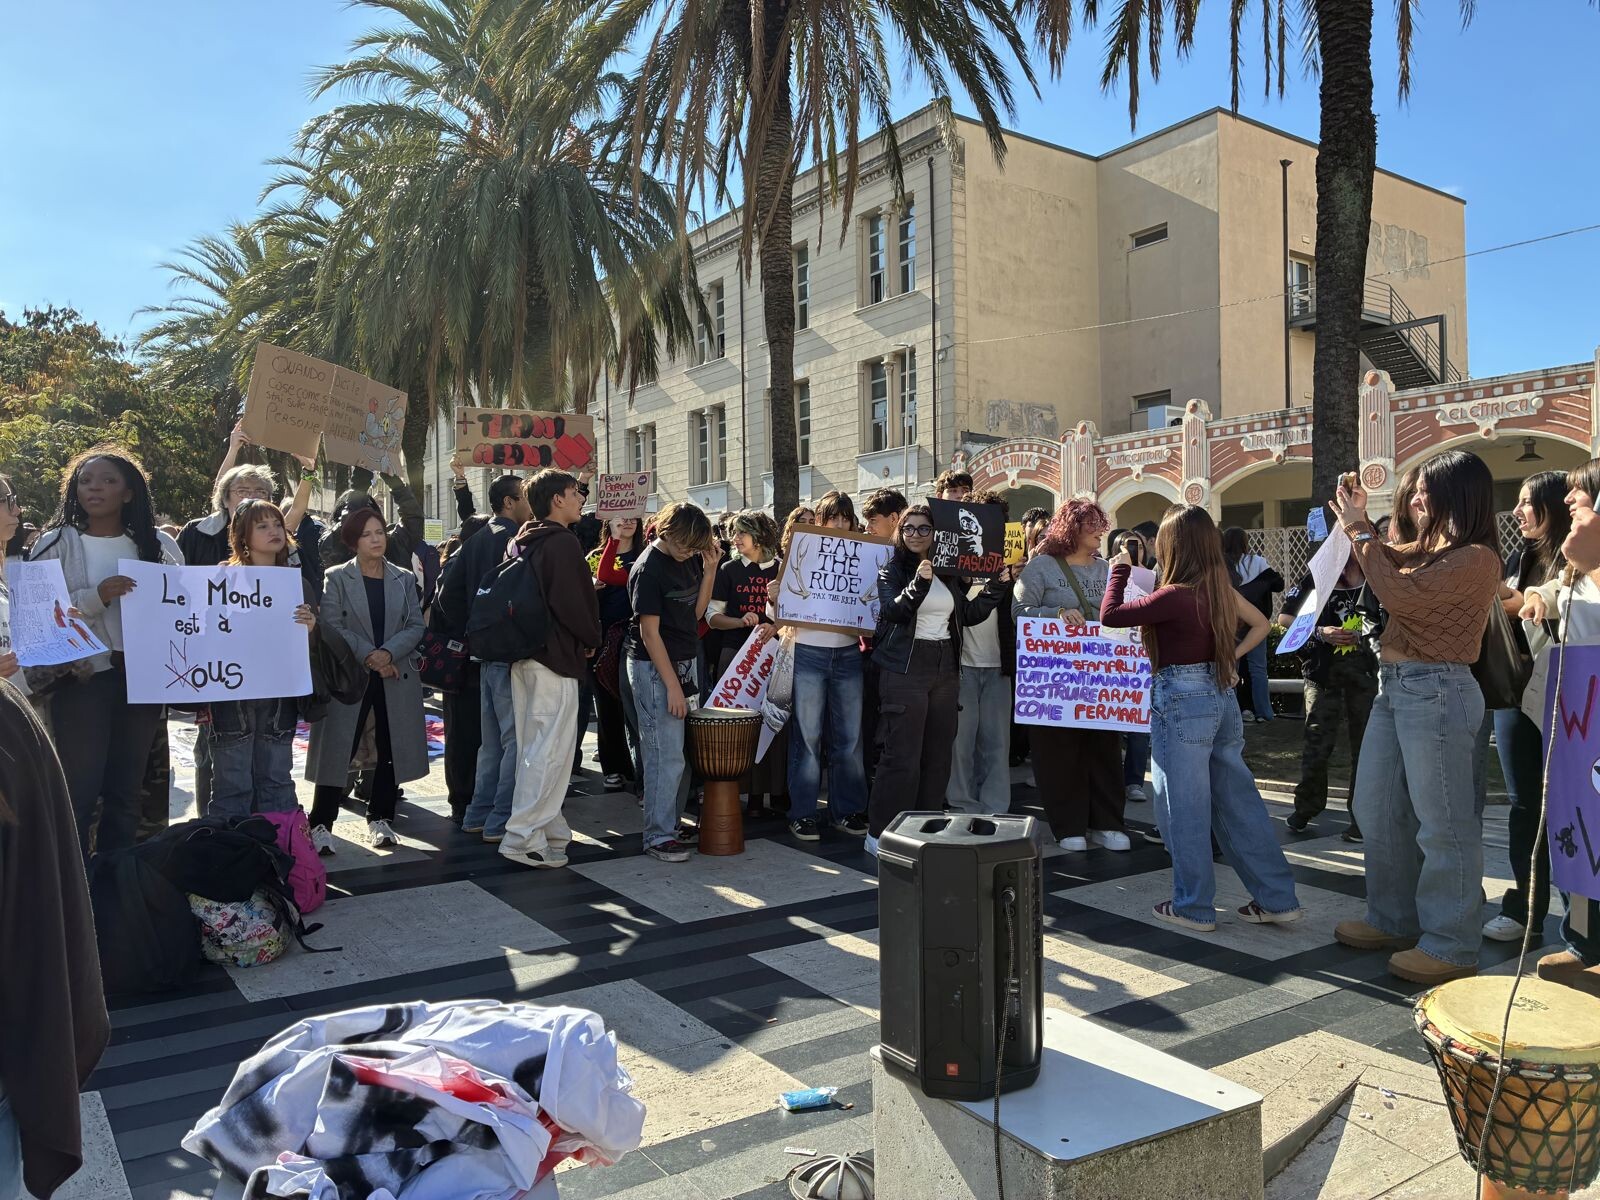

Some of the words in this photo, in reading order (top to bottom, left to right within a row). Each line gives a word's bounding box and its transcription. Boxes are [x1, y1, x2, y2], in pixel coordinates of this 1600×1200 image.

[272, 355, 326, 382] QUANDO
[1449, 398, 1529, 420] ELETTRICA
[478, 414, 565, 439] TERRONI
[1249, 428, 1309, 447] TRAMVIA
[473, 442, 552, 467] MELONI
[991, 453, 1033, 473] MCMIX
[599, 490, 620, 499] ODIA
[605, 480, 634, 490] PERONI
[933, 530, 959, 546] MEGLIO
[1008, 529, 1022, 538] ALLA
[819, 536, 862, 558] EAT
[936, 543, 959, 557] PORCO
[1014, 540, 1023, 550] AL
[818, 553, 860, 577] THE
[957, 551, 1005, 573] FASCISTA
[161, 573, 186, 606] Le
[207, 578, 273, 608] Monde
[736, 585, 768, 594] CANN
[809, 570, 862, 594] RUDE
[811, 592, 826, 600] TAX
[828, 593, 840, 603] THE
[739, 604, 765, 613] MON
[175, 613, 200, 635] est
[217, 614, 232, 633] à
[1042, 622, 1060, 636] LA
[1064, 624, 1100, 637] SOLIT
[1025, 638, 1081, 654] BAMBINI
[1114, 645, 1150, 658] GUERR
[758, 653, 774, 680] NON
[1017, 670, 1049, 684] TUTTI
[1051, 671, 1142, 689] CONTINUANO
[713, 677, 742, 708] ENSO
[1016, 683, 1098, 703] COSTRUIRE
[1098, 688, 1143, 704] ARMI
[1015, 700, 1063, 720] COME
